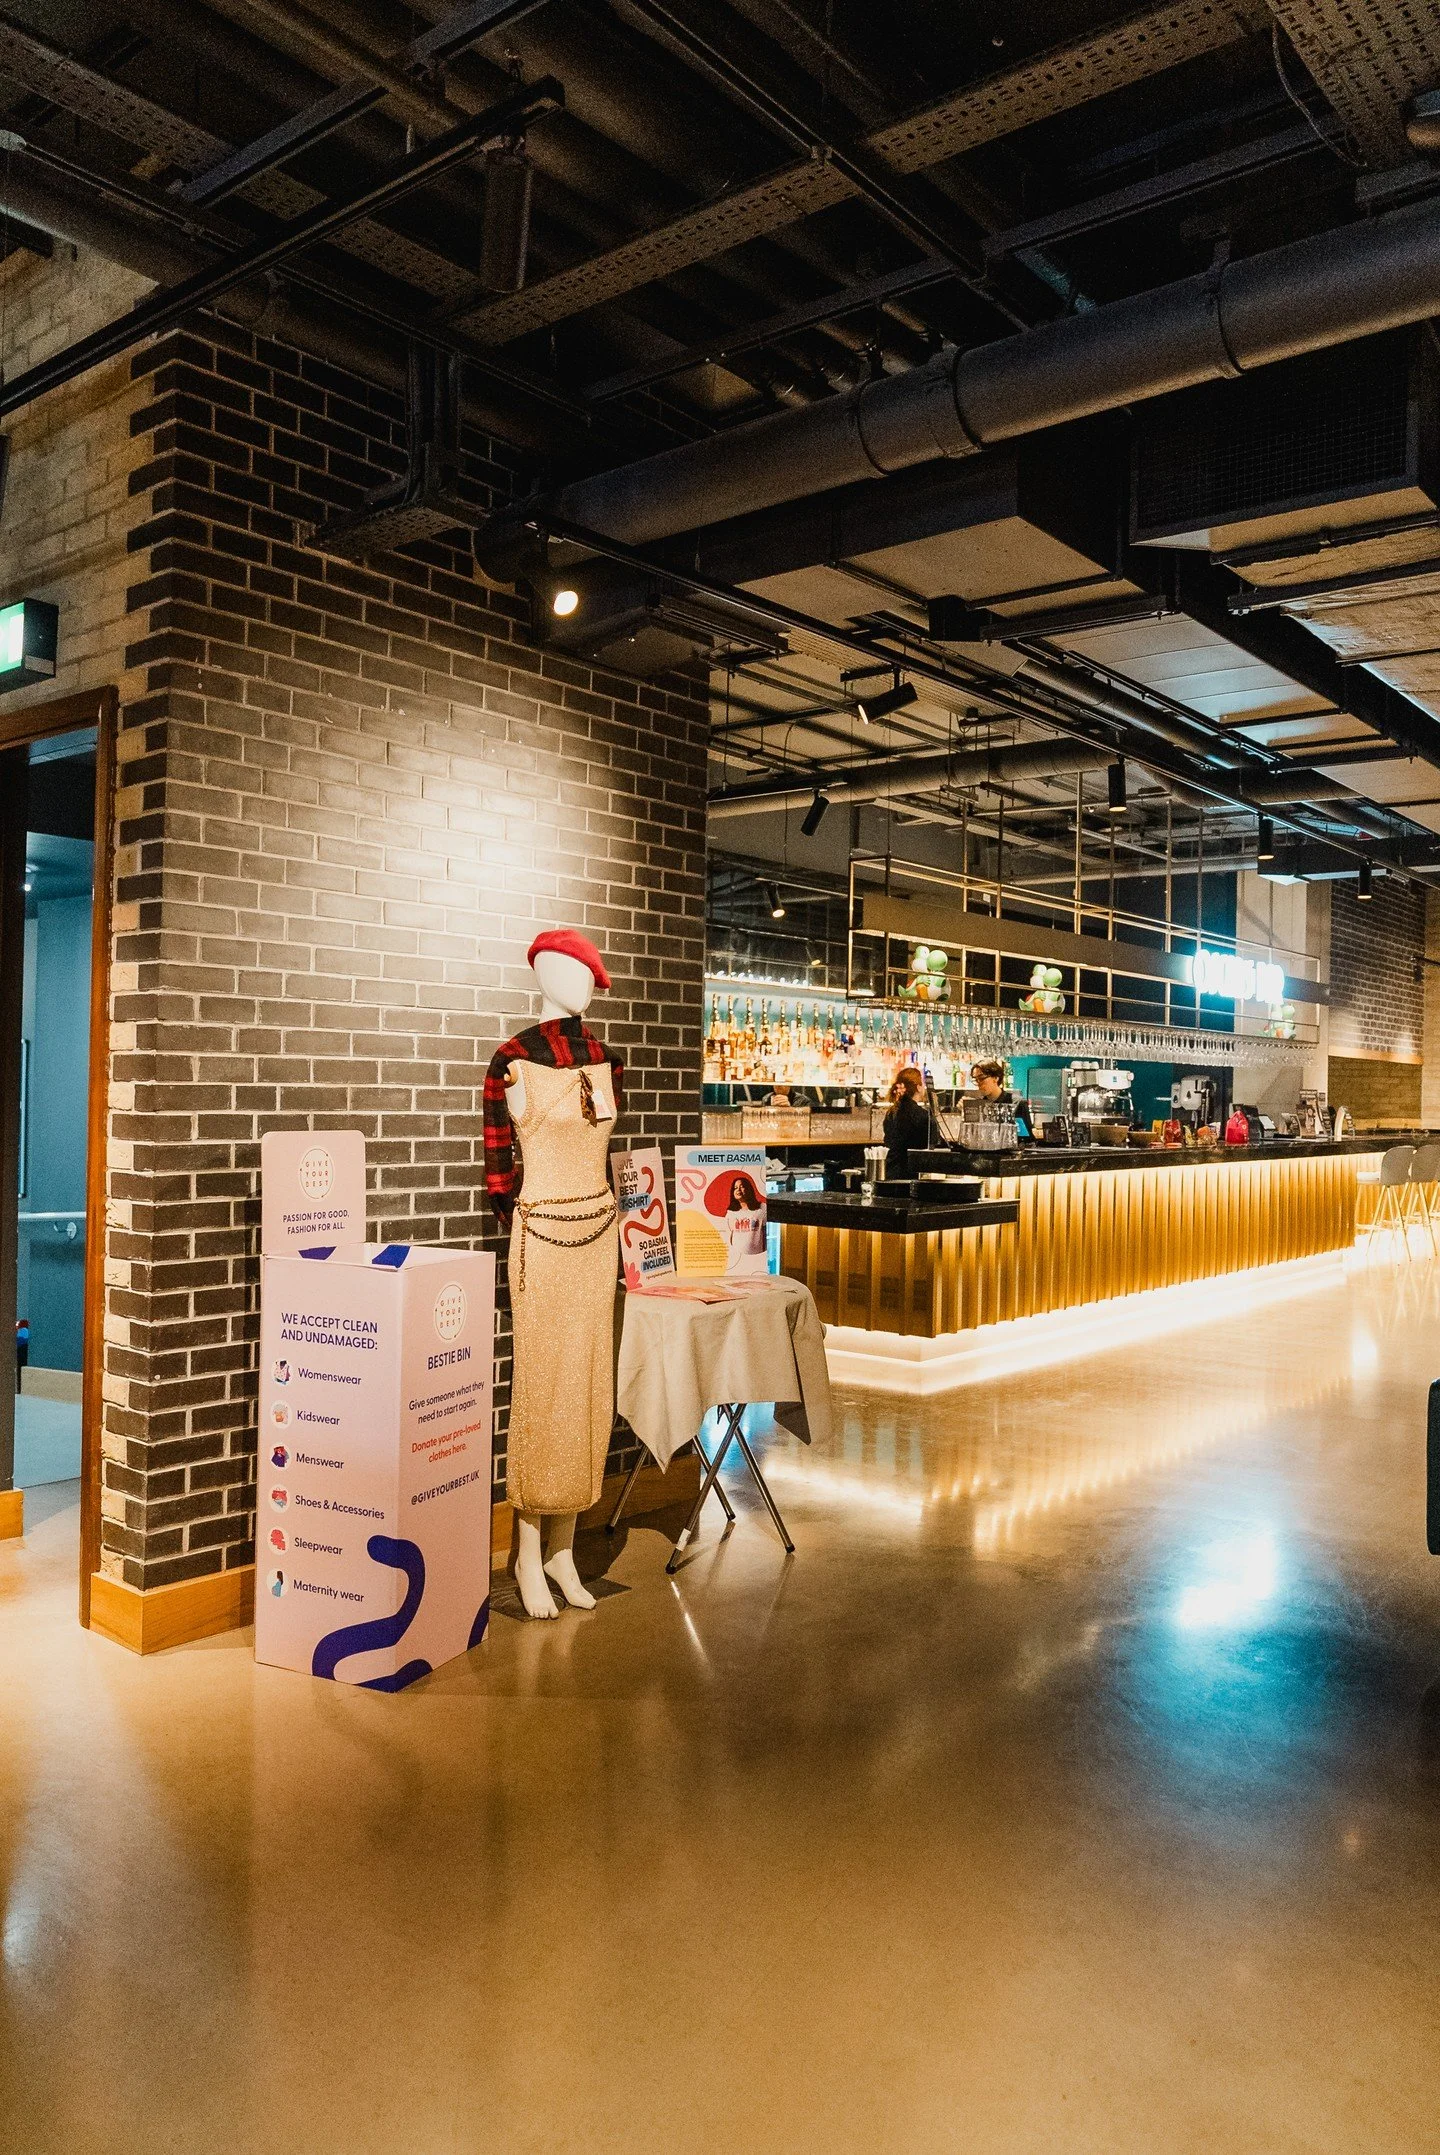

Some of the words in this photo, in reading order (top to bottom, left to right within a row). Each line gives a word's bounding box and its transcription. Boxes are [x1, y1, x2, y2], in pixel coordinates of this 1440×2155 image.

[698, 1154, 725, 1162] MEET
[727, 1154, 761, 1162] BASMA
[618, 1171, 638, 1184] YOUR
[619, 1184, 637, 1196] BEST
[621, 1195, 648, 1210] T-SHIRT
[283, 1212, 312, 1222] PASSION
[314, 1211, 326, 1220] FOR
[328, 1209, 349, 1218] GOOD,
[288, 1224, 316, 1235] FASHION
[318, 1223, 330, 1231] FOR
[639, 1241, 647, 1250] SO
[648, 1236, 668, 1248] BASMA
[644, 1249, 656, 1259] CAN
[657, 1246, 669, 1256] FEEL
[643, 1256, 670, 1270] INCLUDED
[441, 1296, 460, 1306] GIVE
[441, 1307, 460, 1317] YOUR
[282, 1312, 298, 1324] WE
[300, 1315, 340, 1329] ACCEPT
[343, 1320, 378, 1333] CLEAN
[281, 1329, 303, 1341] AND
[305, 1332, 378, 1350] UNDAMAGED:
[428, 1350, 455, 1370] BESTIE
[458, 1346, 471, 1362] BIN
[298, 1368, 361, 1385] Womenswear
[409, 1400, 425, 1411] Give
[426, 1391, 455, 1406] someone
[456, 1384, 471, 1396] what
[472, 1381, 484, 1392] they
[297, 1410, 340, 1425] Kidswear
[418, 1410, 435, 1424] need
[436, 1409, 443, 1418] to
[444, 1403, 459, 1416] start
[459, 1398, 477, 1412] again.
[412, 1437, 437, 1453] Donate
[438, 1433, 453, 1446] your
[453, 1420, 481, 1441] pre-loved
[429, 1447, 451, 1462] clothes
[452, 1442, 467, 1456] here.
[296, 1453, 344, 1469] Menswear
[411, 1470, 479, 1506] @GIVEYOURBEST.UK
[296, 1495, 321, 1509] Shoes
[324, 1500, 330, 1510] &
[332, 1502, 385, 1520] Accessories
[295, 1538, 342, 1555] Sleepwear
[294, 1579, 338, 1599] Maternity
[340, 1591, 364, 1602] wear
